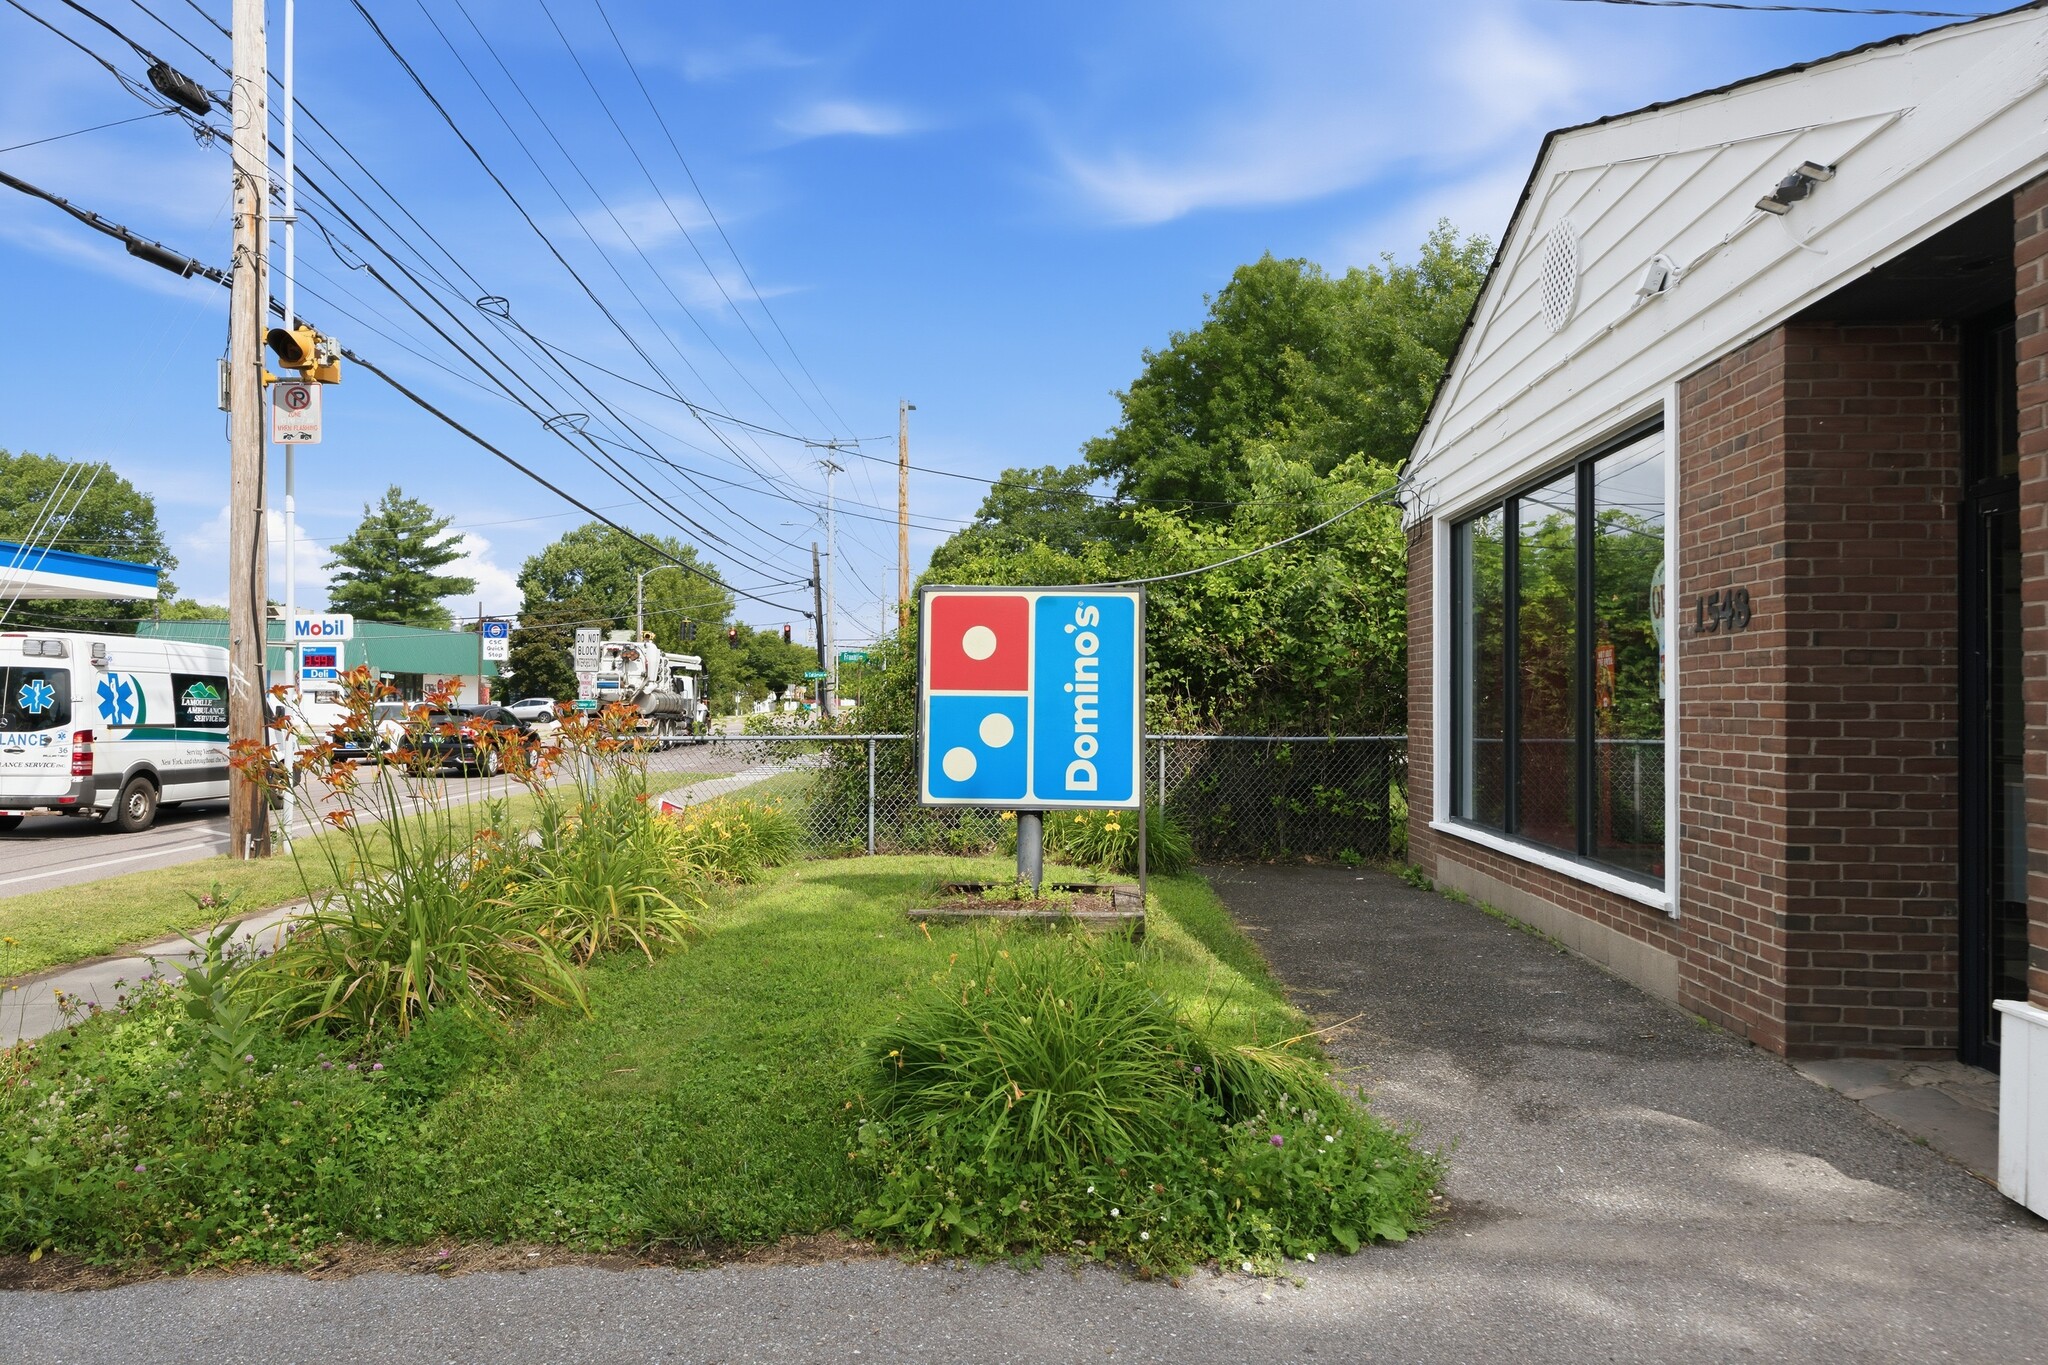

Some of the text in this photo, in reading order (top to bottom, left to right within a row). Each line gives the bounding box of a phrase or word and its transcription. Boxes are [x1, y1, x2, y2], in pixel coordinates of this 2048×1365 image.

[1695, 588, 1751, 632] 1548
[295, 620, 343, 636] Mobil
[577, 633, 599, 643] DO NOT
[577, 645, 597, 655] BLOCK
[310, 669, 329, 678] Deli
[181, 698, 213, 706] LAMOILLE
[1063, 605, 1100, 791] Domino's
[186, 706, 225, 715] AMBULANCE
[193, 714, 219, 722] SERVICE
[0, 733, 48, 746] LANCE
